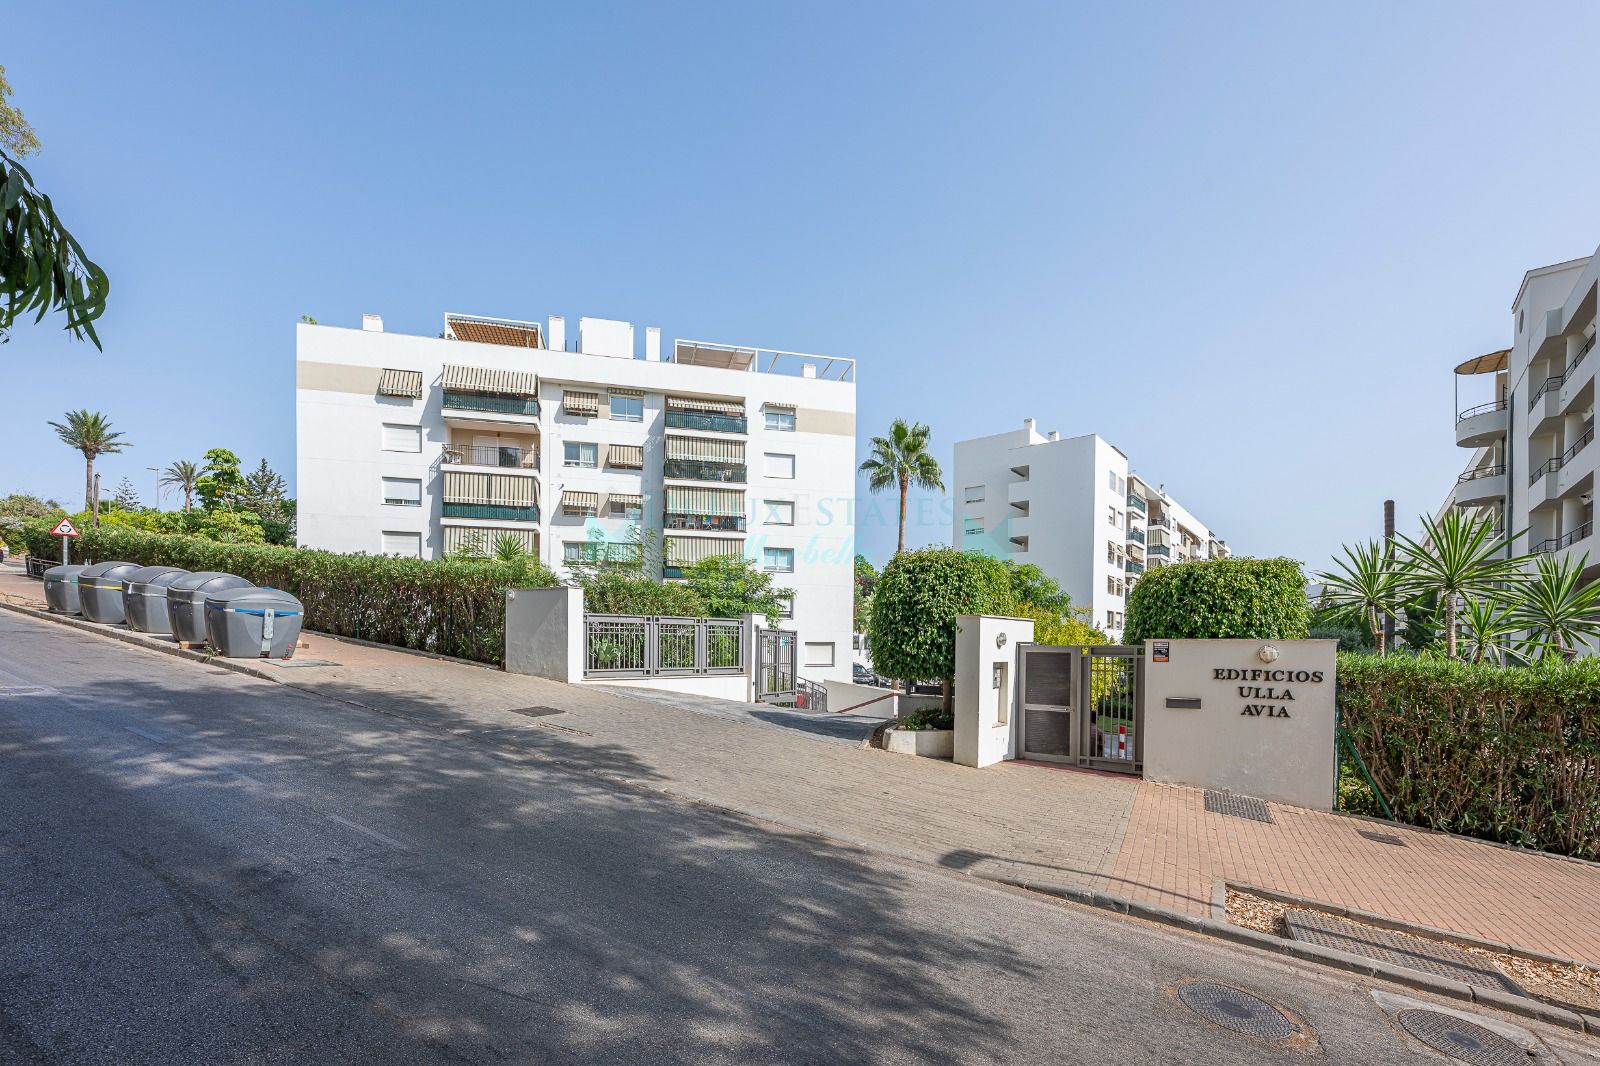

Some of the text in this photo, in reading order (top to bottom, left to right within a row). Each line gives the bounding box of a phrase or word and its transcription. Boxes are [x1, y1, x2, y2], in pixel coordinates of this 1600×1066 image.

[1213, 668, 1324, 683] EDIFICIOS
[1238, 686, 1295, 701] ULLA
[1240, 704, 1291, 719] AVIA
